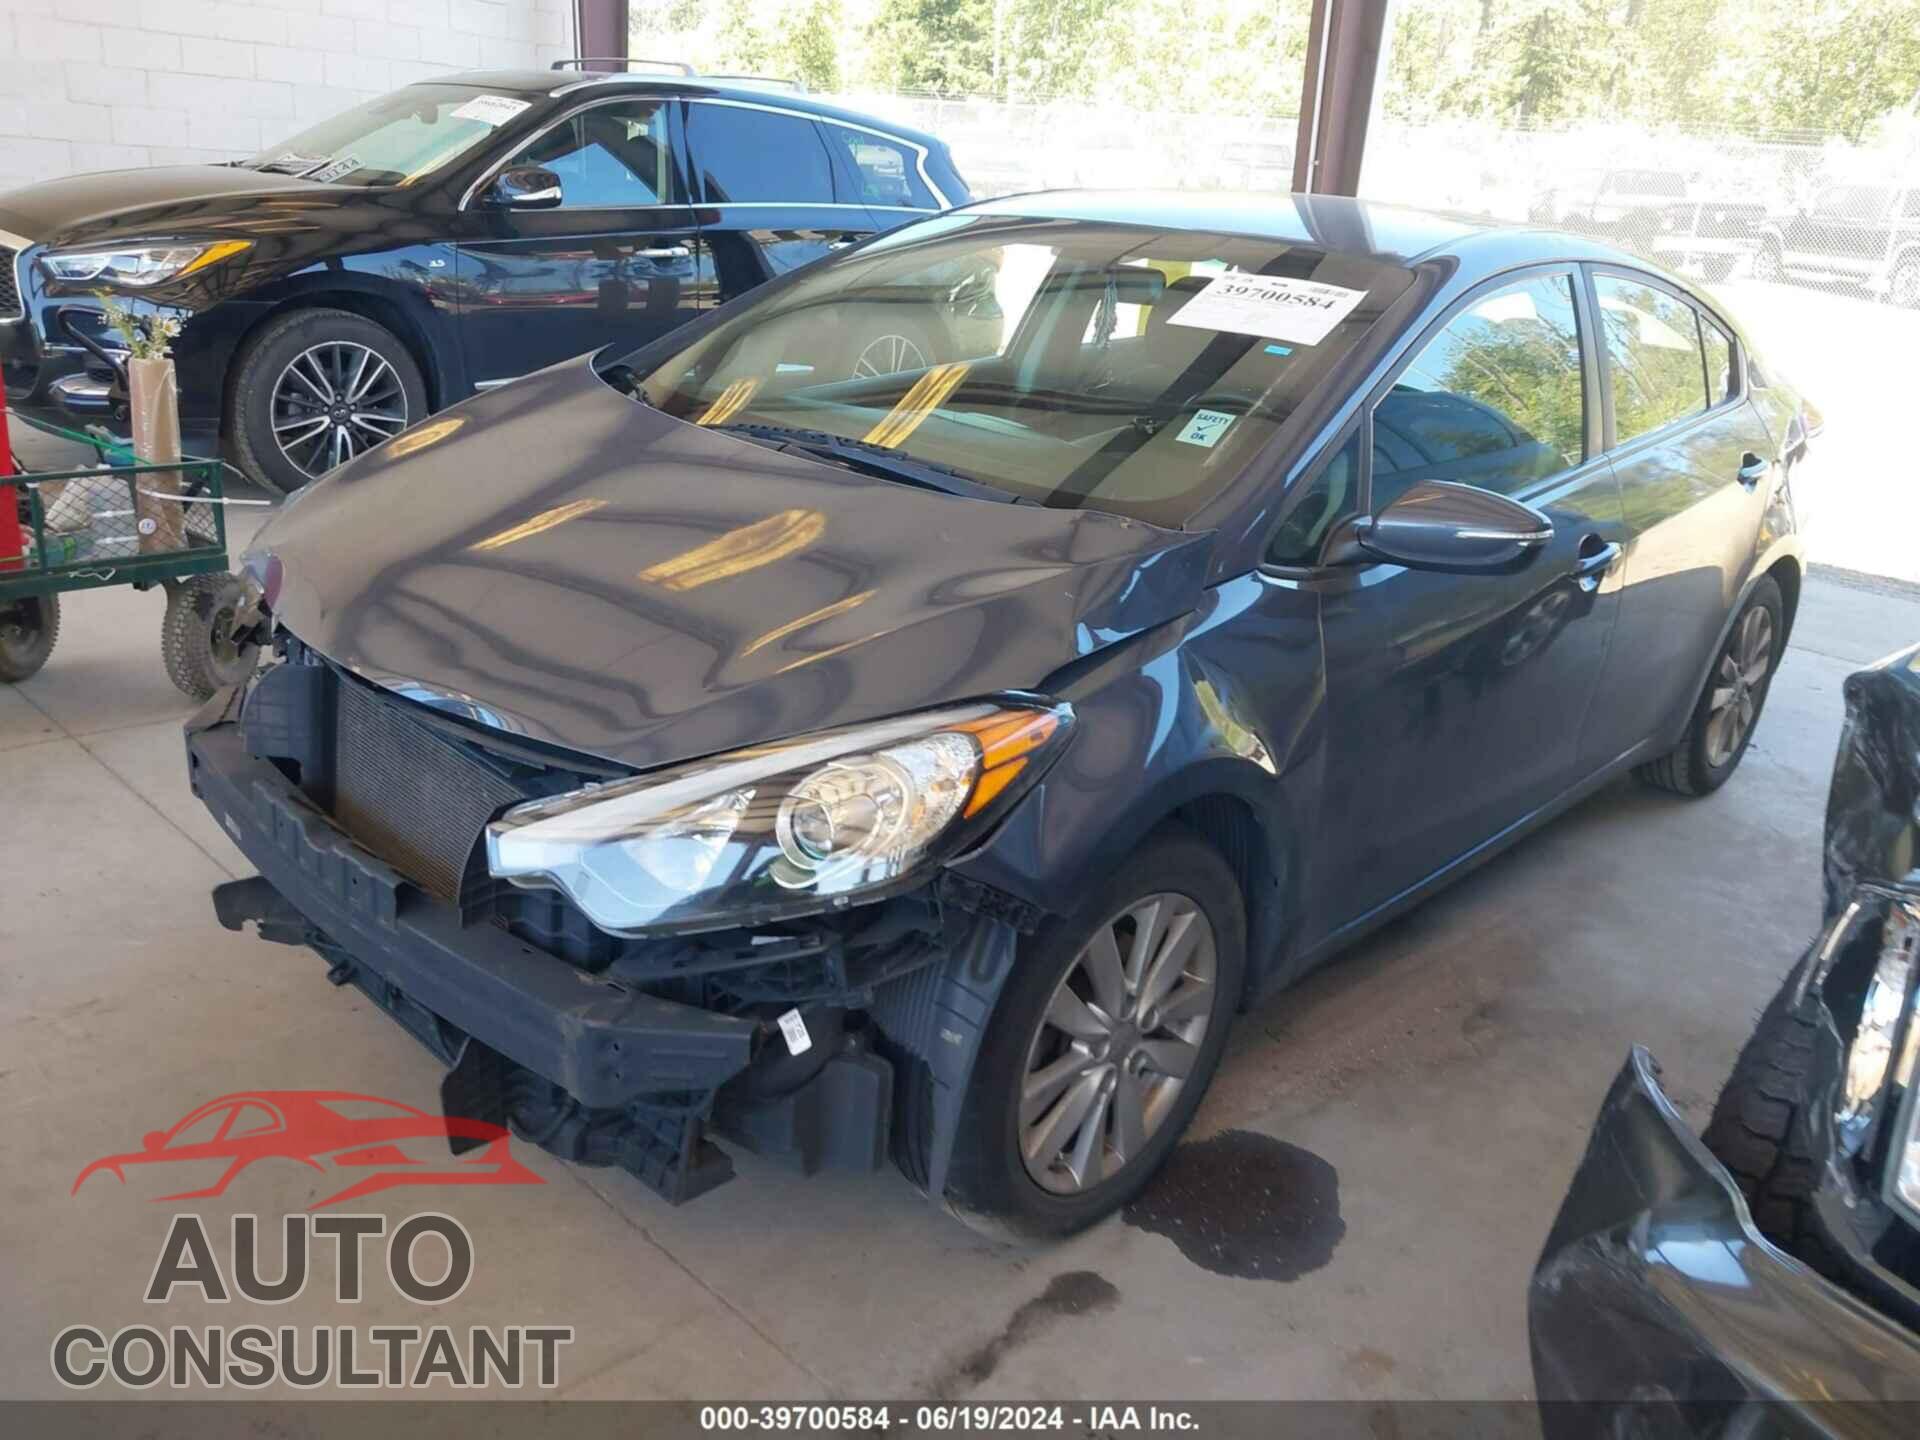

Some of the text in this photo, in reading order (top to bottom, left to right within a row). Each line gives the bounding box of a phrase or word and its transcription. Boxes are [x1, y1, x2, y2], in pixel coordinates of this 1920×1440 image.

[1216, 284, 1336, 310] 39700584
[1196, 413, 1230, 425] SAFETY
[1190, 431, 1208, 441] OK
